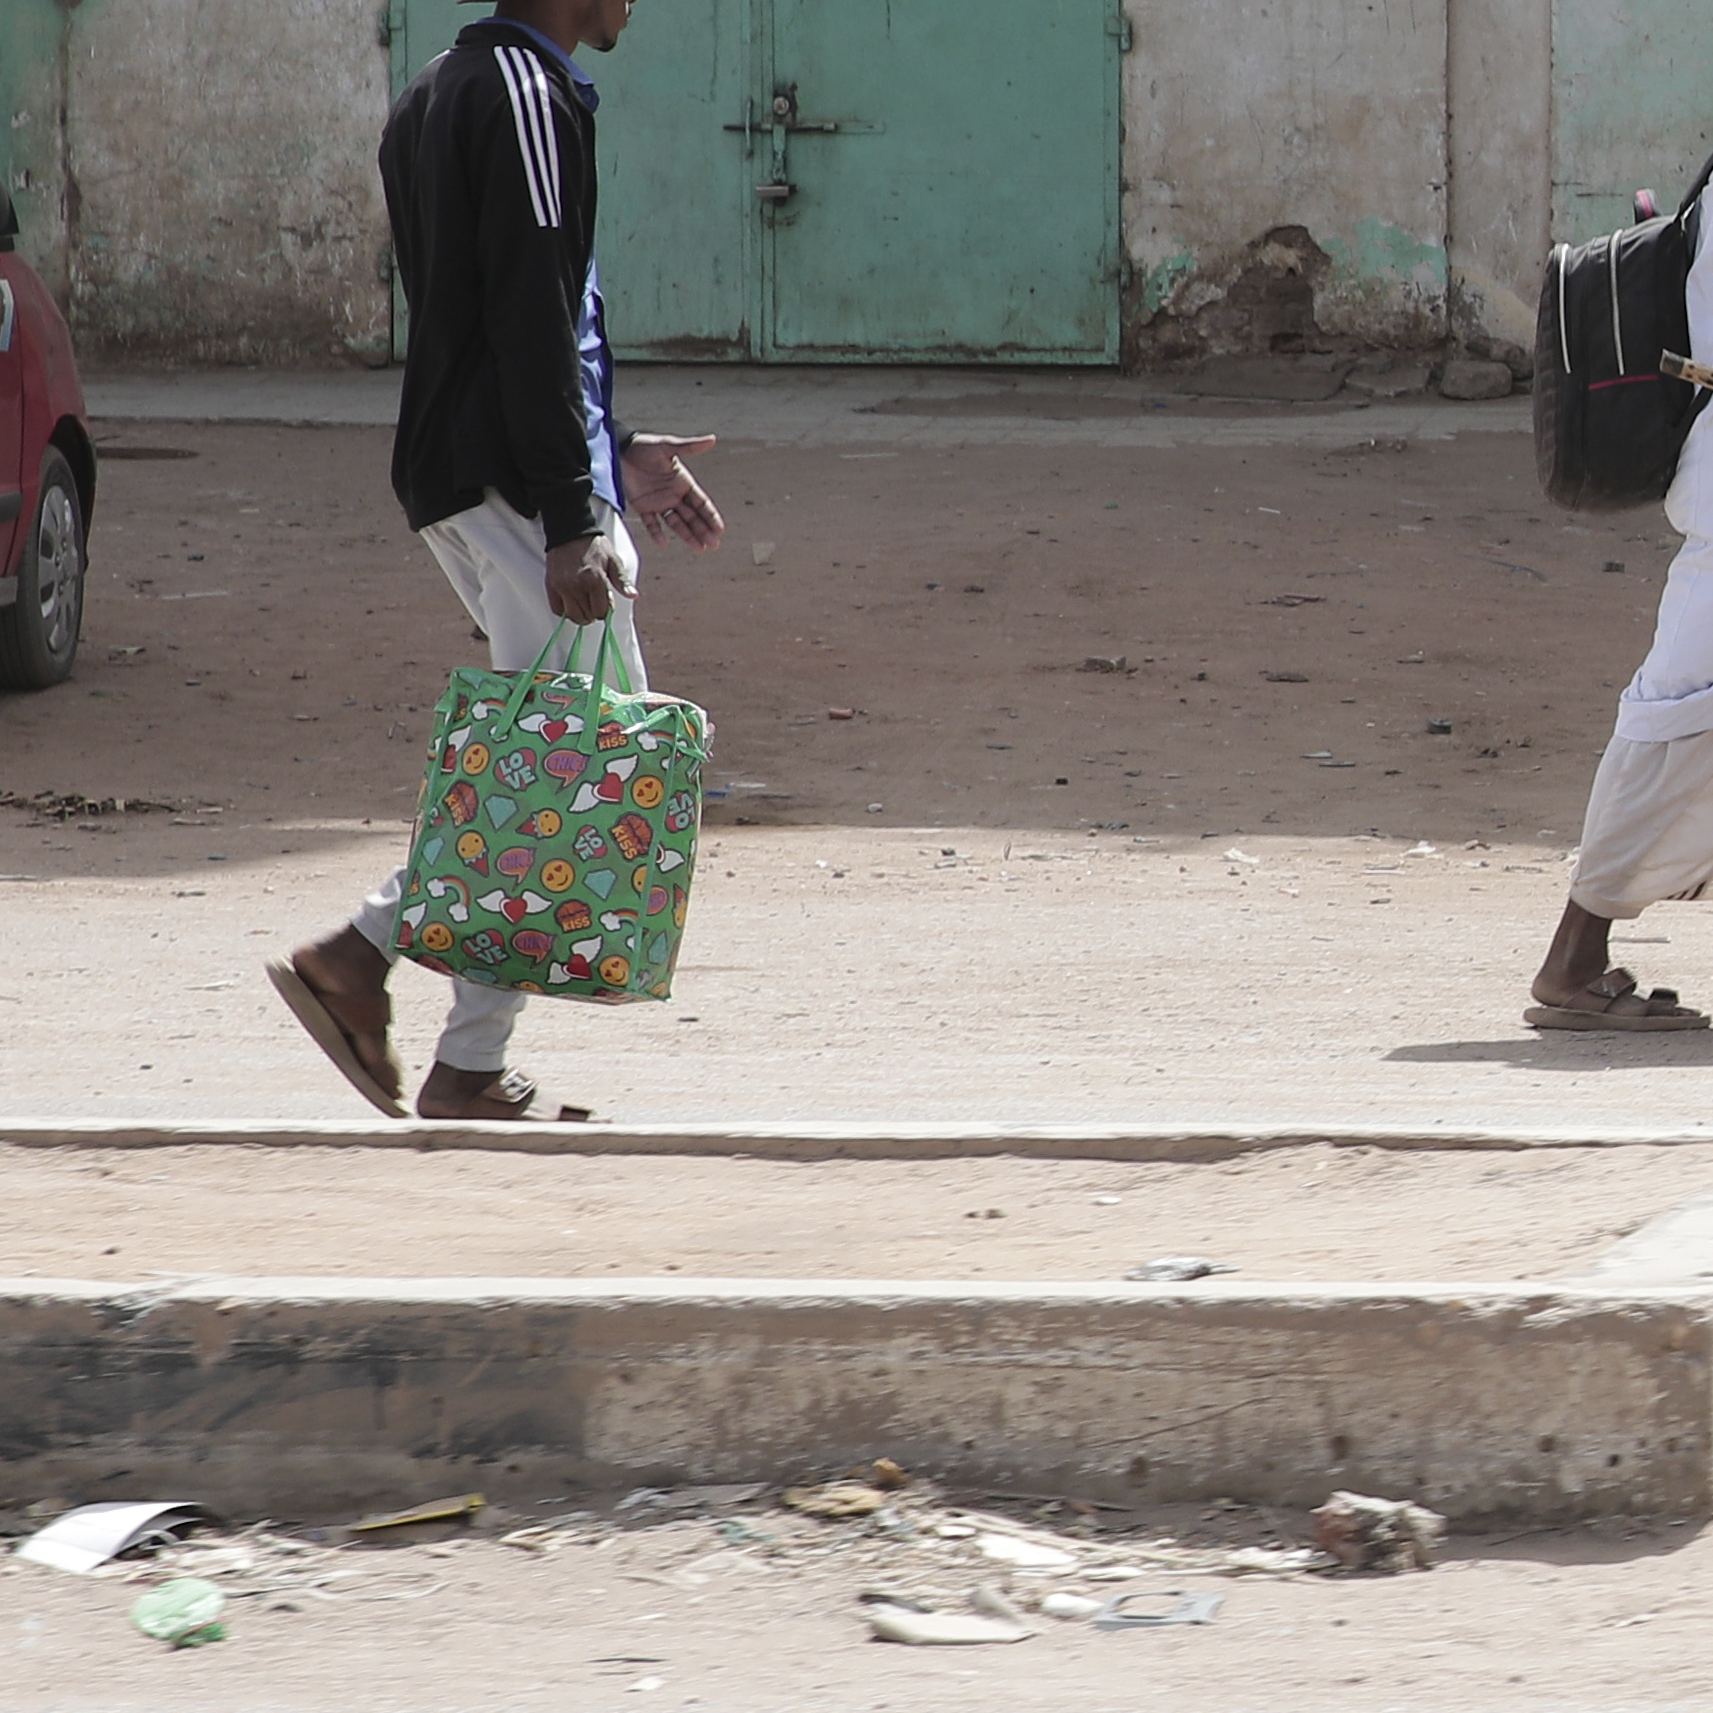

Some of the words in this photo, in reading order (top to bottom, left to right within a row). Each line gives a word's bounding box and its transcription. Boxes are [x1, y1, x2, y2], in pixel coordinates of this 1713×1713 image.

[598, 734, 628, 750] KISS
[611, 825, 637, 859] KISS
[562, 916, 591, 931] KISS
